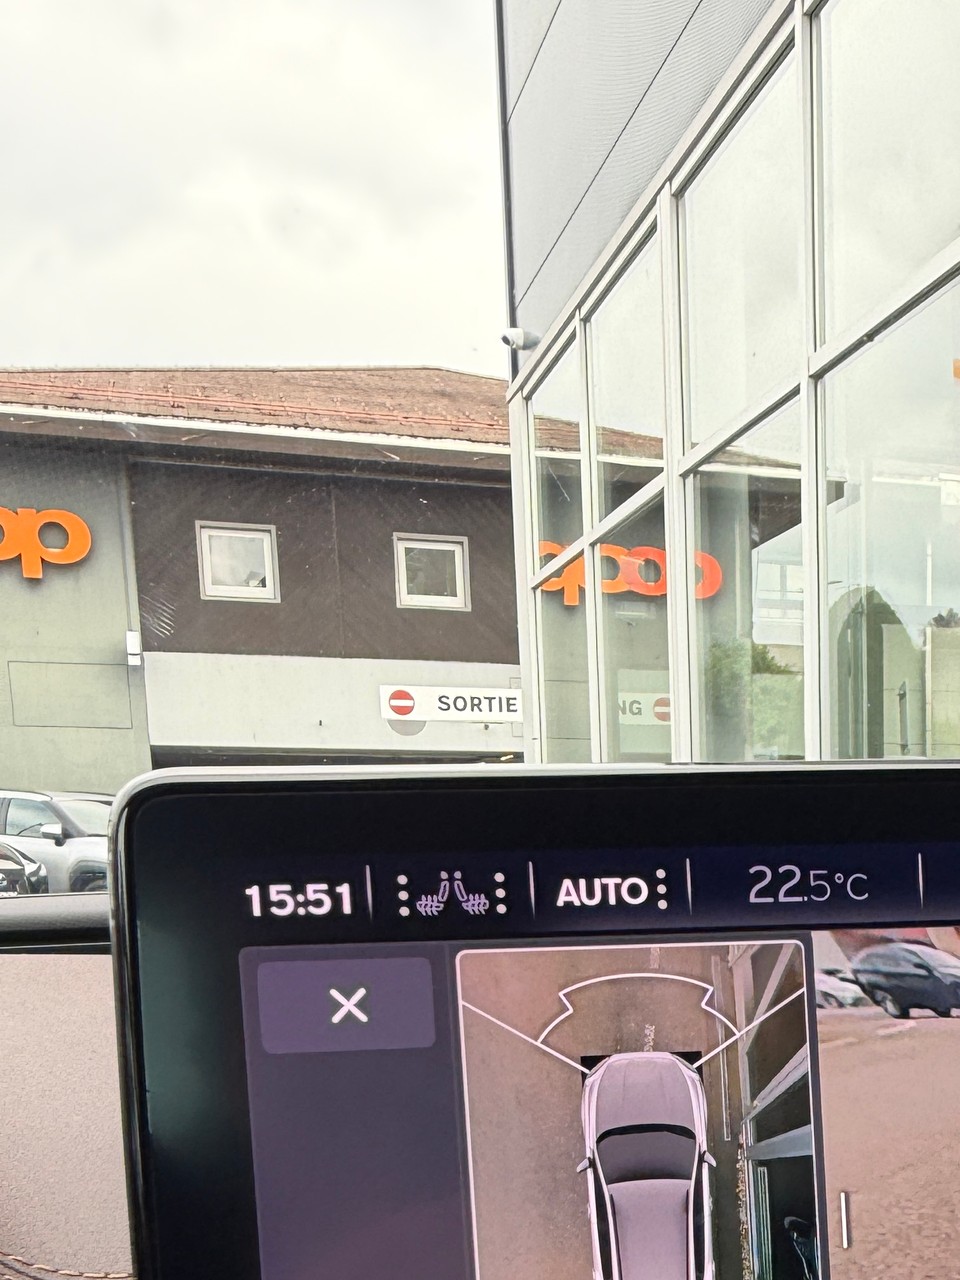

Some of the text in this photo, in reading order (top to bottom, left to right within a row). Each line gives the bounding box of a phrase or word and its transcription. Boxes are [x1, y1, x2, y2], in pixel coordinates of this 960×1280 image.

[437, 695, 518, 713] SORTIE
[245, 882, 352, 917] 15:51
[556, 877, 649, 907] AUTO
